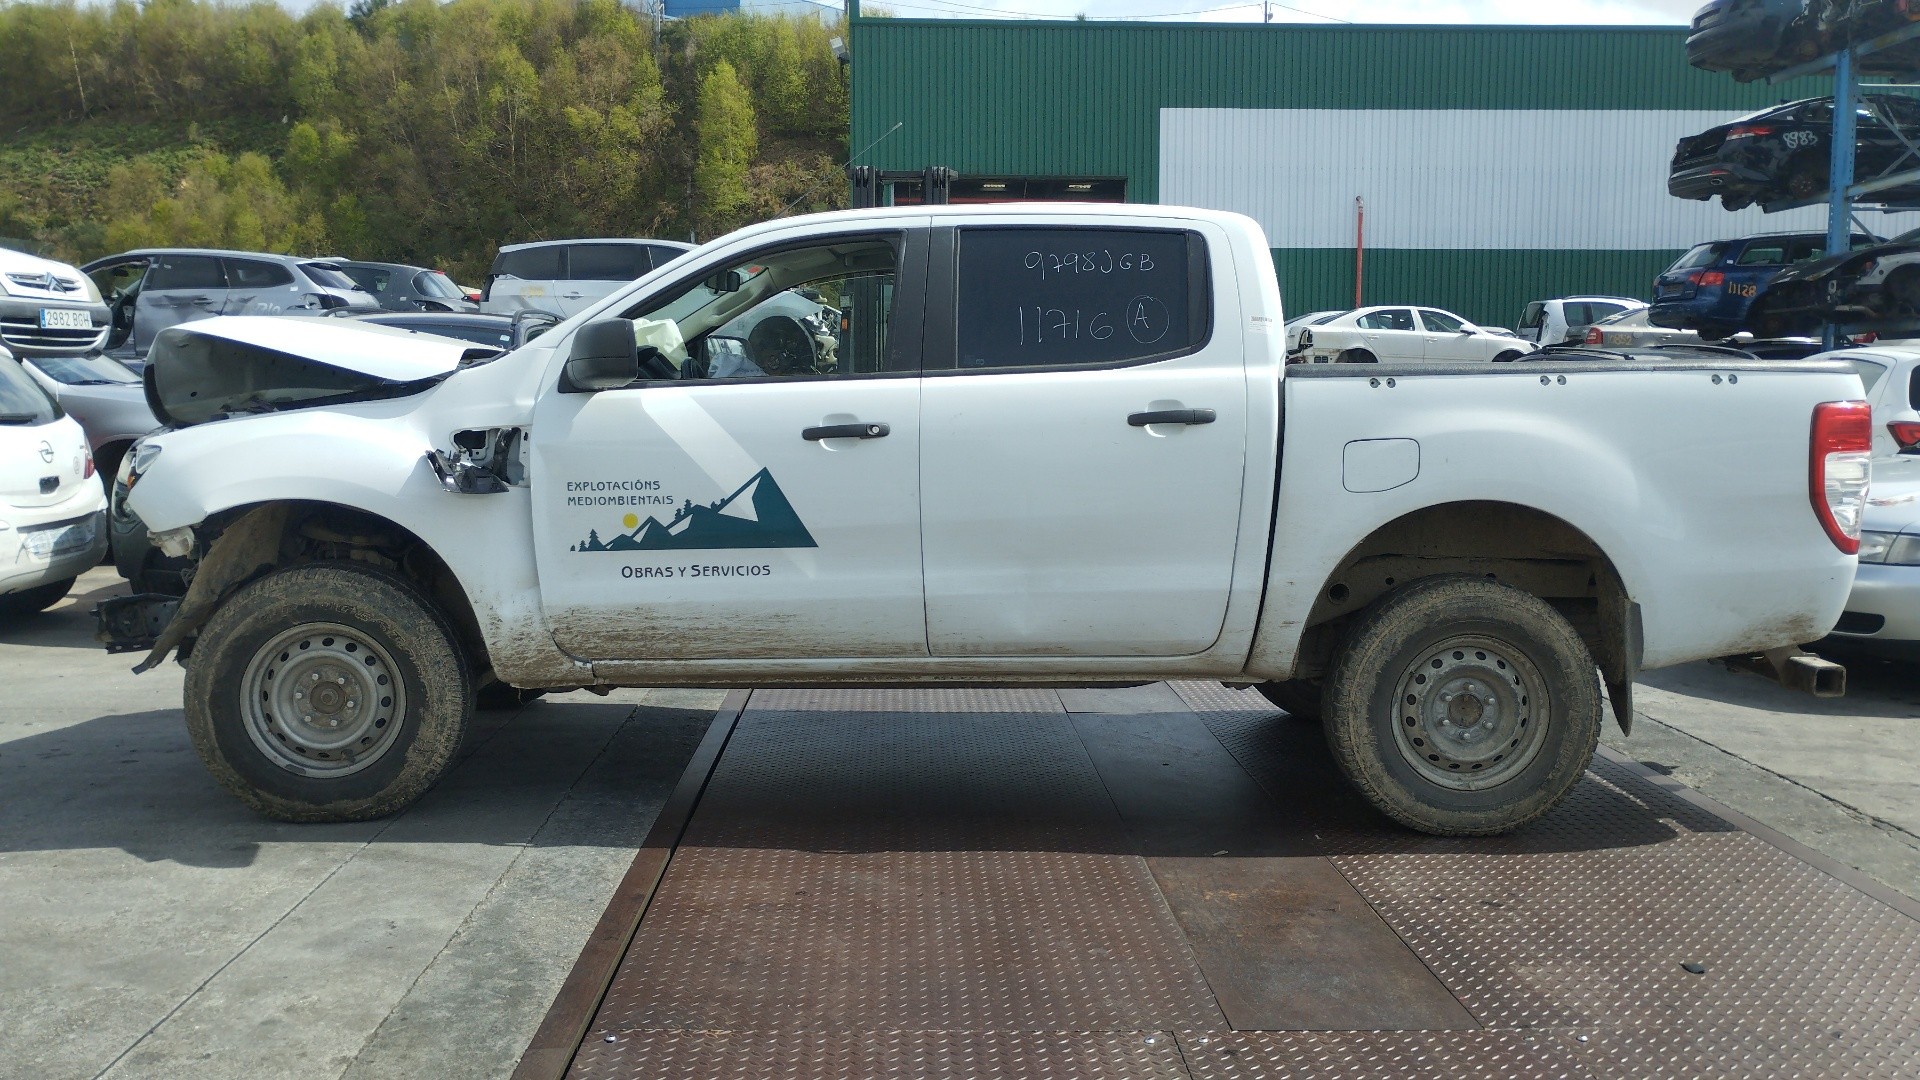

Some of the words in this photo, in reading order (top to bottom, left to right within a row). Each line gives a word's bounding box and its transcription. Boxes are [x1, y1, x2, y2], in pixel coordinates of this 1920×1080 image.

[1782, 130, 1818, 149] 8983
[1019, 305, 1114, 346] 11716
[567, 479, 661, 492] EXPLOTACIÓNS
[567, 495, 674, 506] MEDIOMBIENTAIS
[621, 565, 674, 579] OBRAS
[690, 564, 771, 577] SERVICIOS
